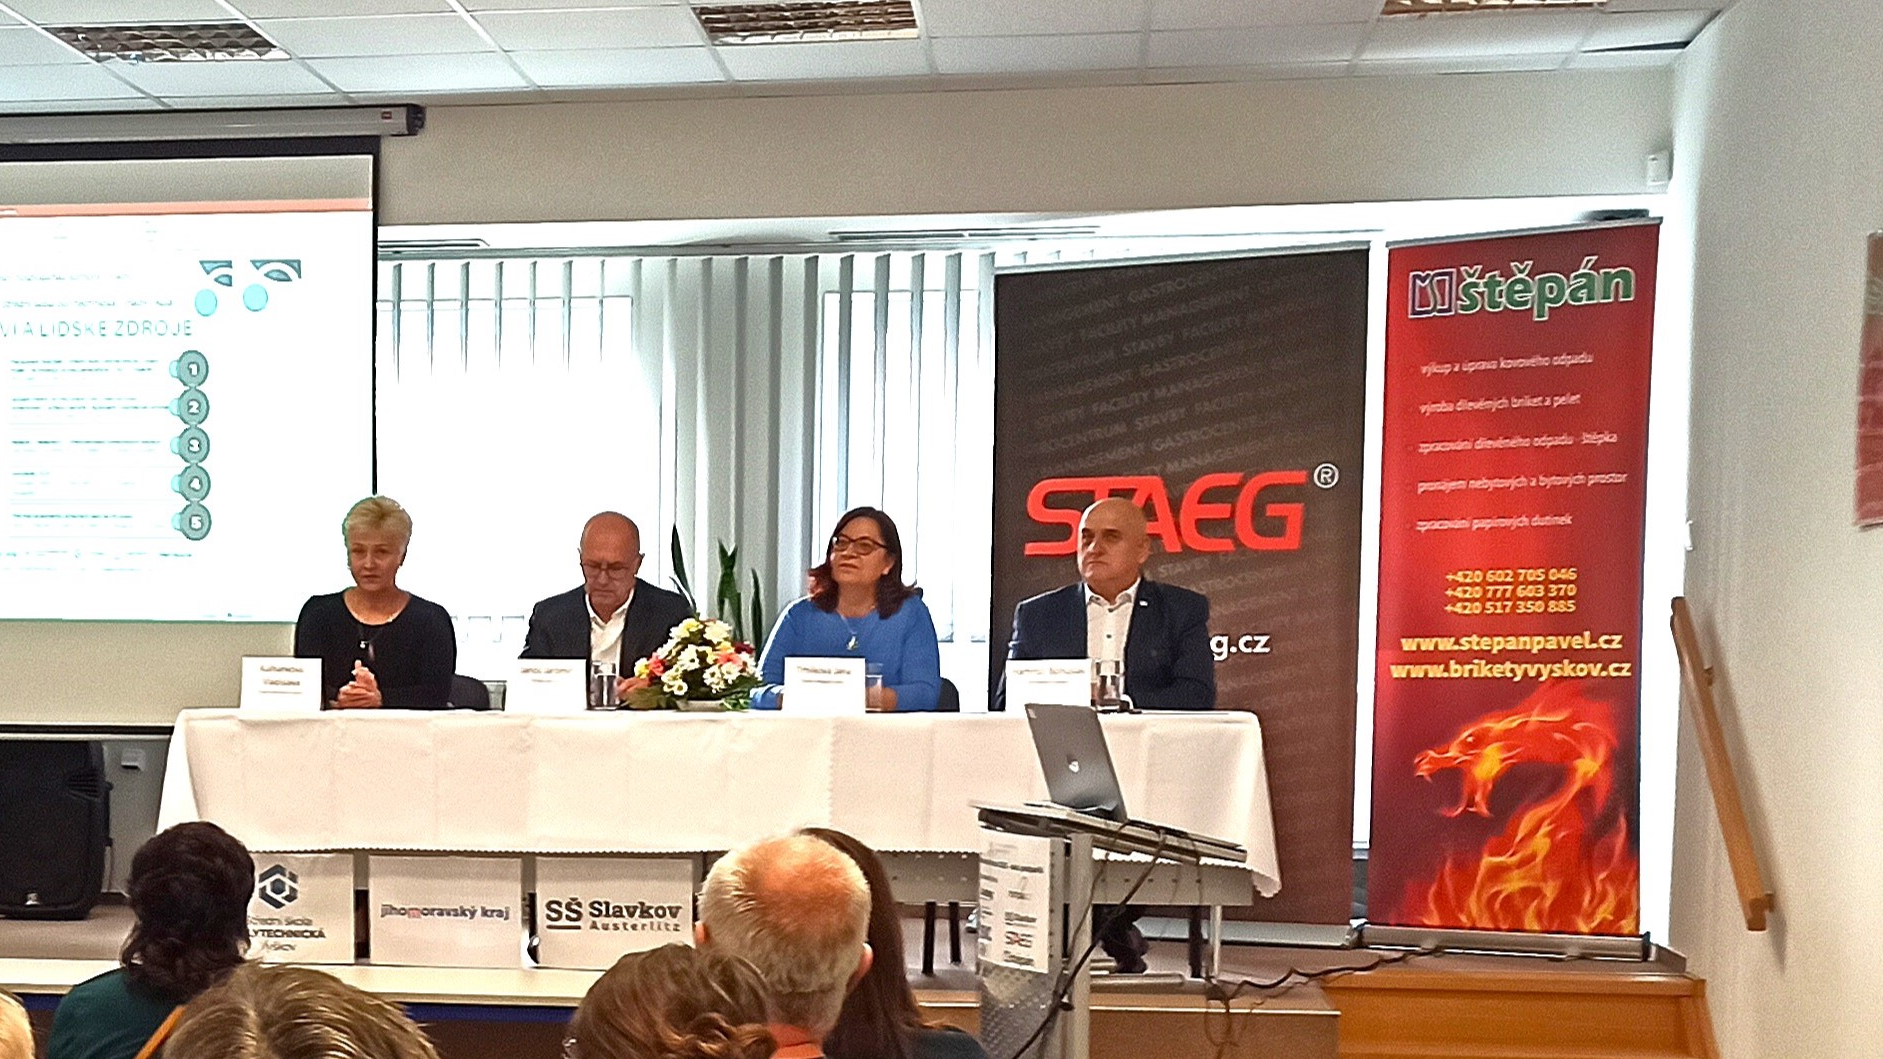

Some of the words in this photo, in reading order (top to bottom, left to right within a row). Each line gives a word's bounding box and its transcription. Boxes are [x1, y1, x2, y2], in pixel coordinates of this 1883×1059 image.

[1458, 255, 1636, 322] štěpán
[115, 320, 192, 337] ZDROJE
[188, 362, 199, 376] 1
[187, 399, 201, 414] 2
[188, 437, 201, 453] 3
[189, 476, 202, 491] 4
[1024, 469, 1310, 556] STAEG
[189, 515, 203, 531] 5
[1445, 569, 1484, 583] +420
[1485, 568, 1515, 582] 602
[1517, 567, 1546, 582] 705
[1548, 567, 1578, 581] 046
[1444, 585, 1483, 599] +420
[1485, 584, 1515, 598] 777
[1516, 583, 1546, 597] 603
[1547, 583, 1578, 597] 370
[1443, 601, 1483, 615] +420
[1484, 600, 1514, 614] 517
[1515, 600, 1545, 614] 350
[1546, 599, 1577, 613] 885
[1400, 631, 1623, 654] www.stepanpavel.cz
[1389, 659, 1632, 682] www.briketyvyskov.cz
[380, 902, 479, 921] jihomoravský
[480, 904, 510, 921] kraj
[544, 897, 584, 923] SŠ
[587, 899, 683, 921] Slavkov
[588, 920, 682, 933] Austerlitz
